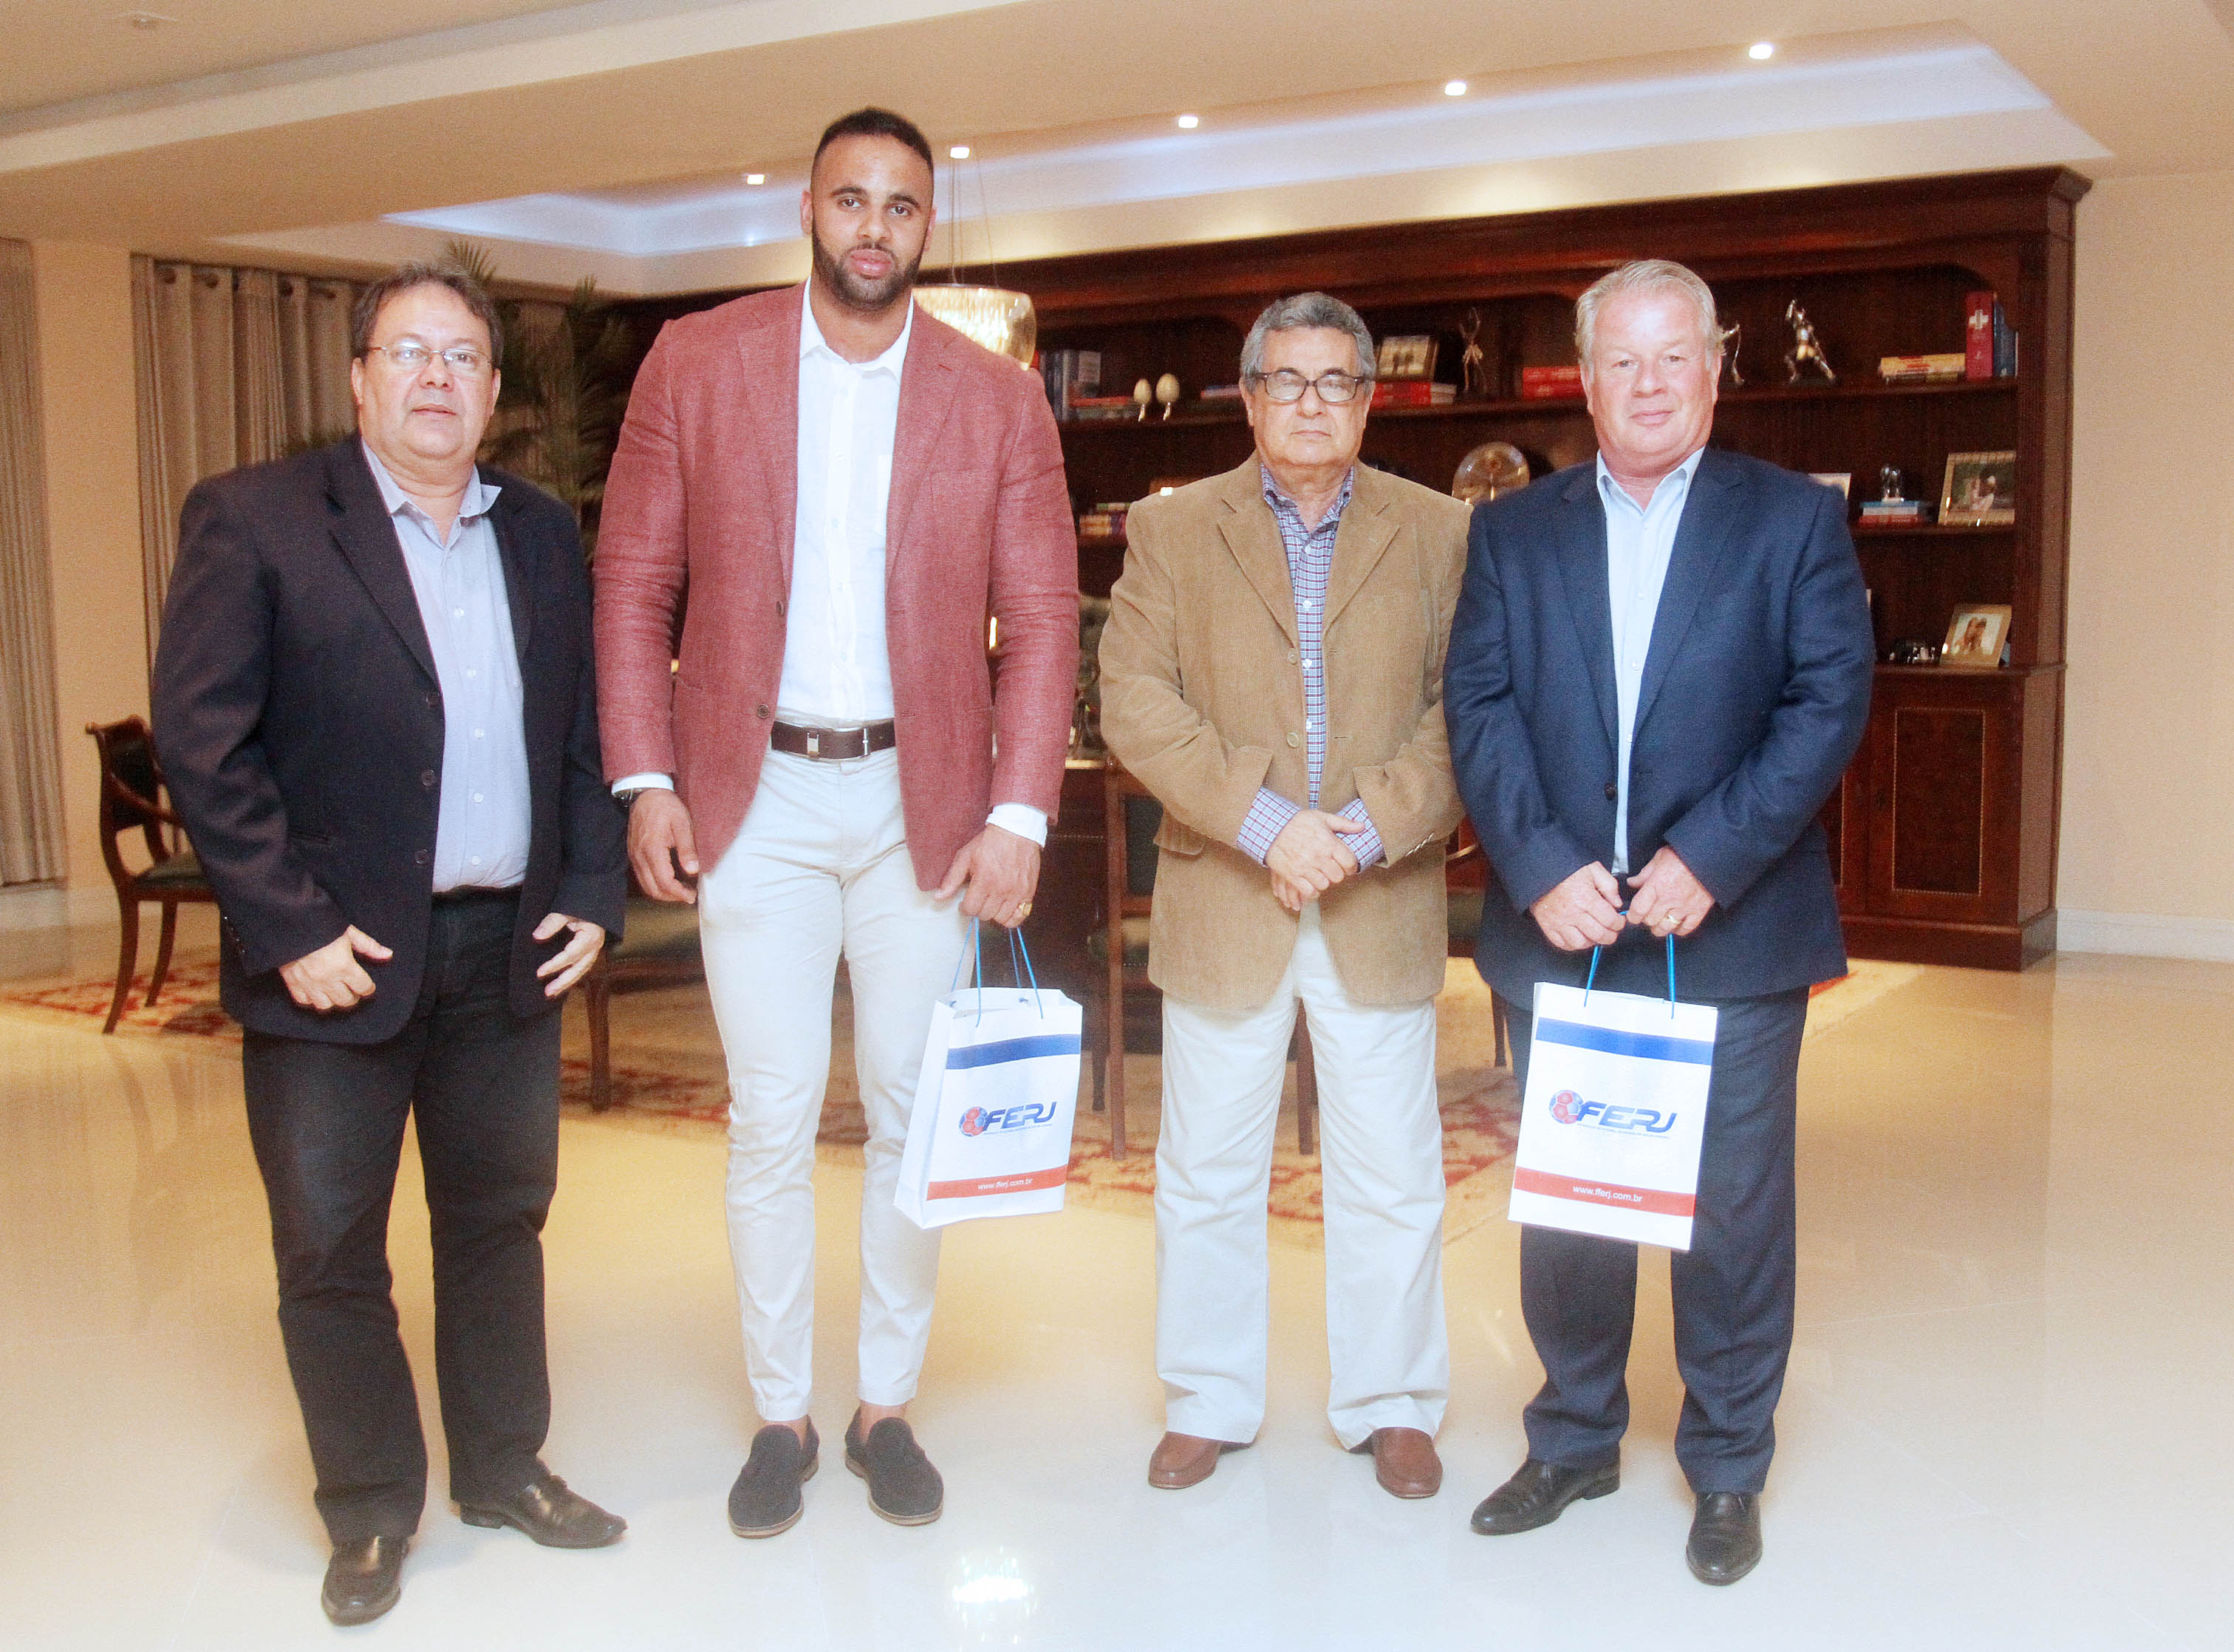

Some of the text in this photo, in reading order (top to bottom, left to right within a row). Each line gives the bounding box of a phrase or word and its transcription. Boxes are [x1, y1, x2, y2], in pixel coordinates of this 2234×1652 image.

[983, 1101, 1057, 1131] FERJ
[1577, 1100, 1678, 1133] FERJ
[1572, 1186, 1643, 1202] www.fferj.com.br
